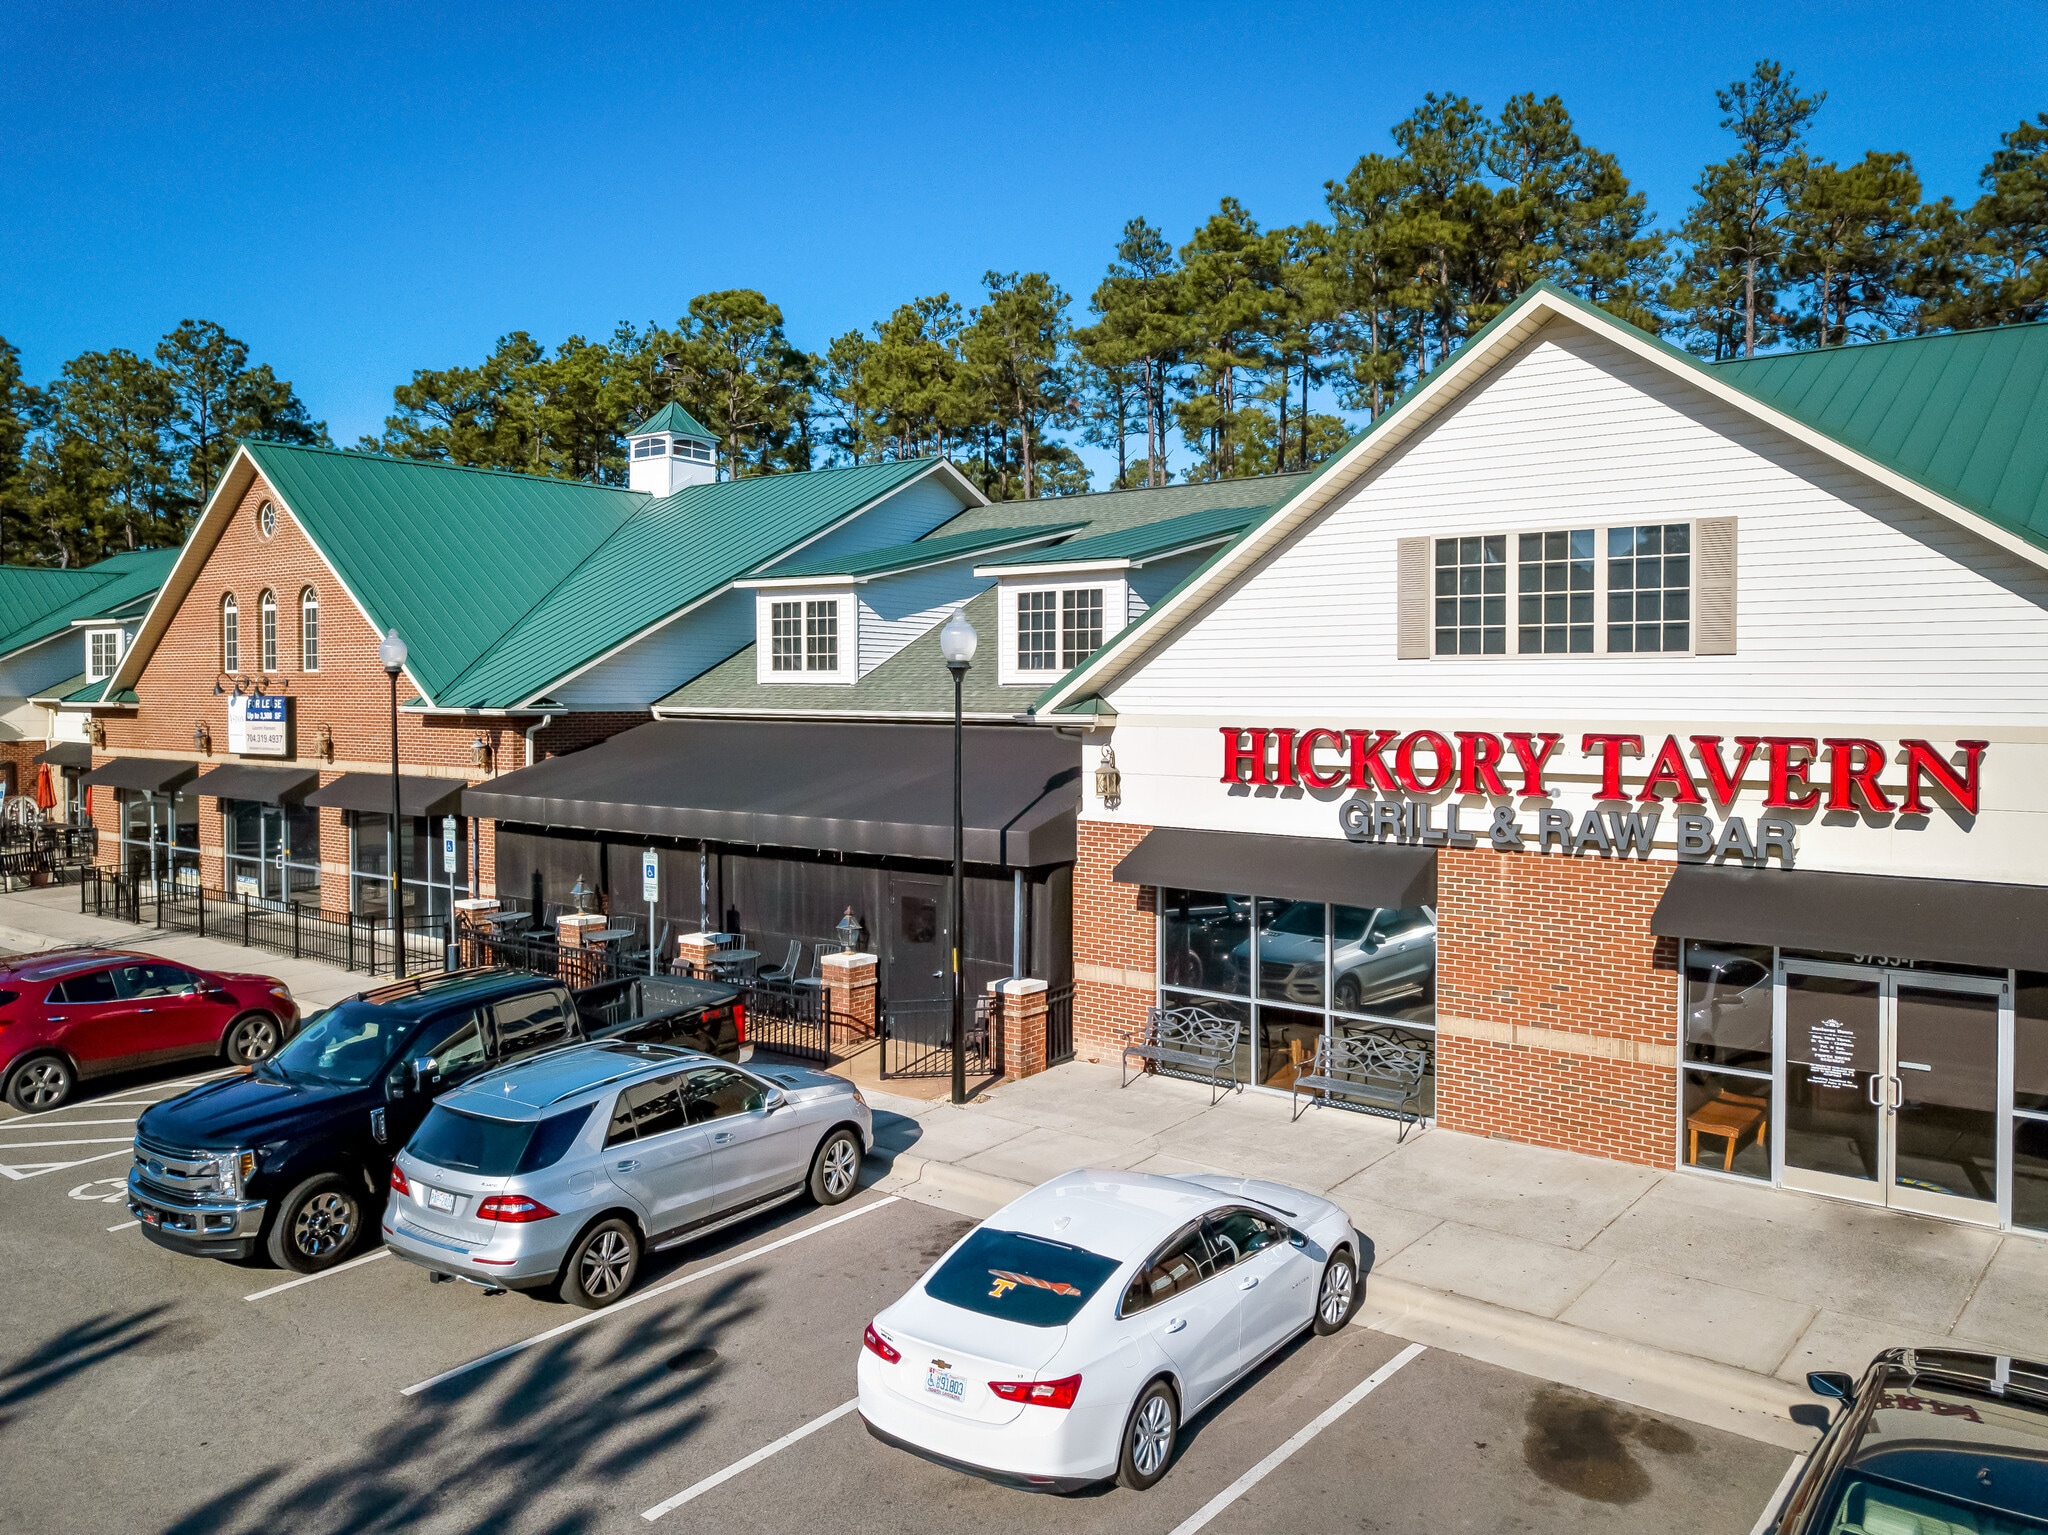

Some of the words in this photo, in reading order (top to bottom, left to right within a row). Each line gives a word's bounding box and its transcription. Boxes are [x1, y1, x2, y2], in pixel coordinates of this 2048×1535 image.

[248, 699, 260, 709] FOR
[261, 699, 282, 709] LEASE
[246, 733, 283, 743] 704.319.4937
[1219, 727, 1563, 798] HICKORY
[1582, 733, 1990, 816] TAVERN
[1338, 798, 1476, 841] GRILL
[1488, 805, 1523, 844] &
[1538, 808, 1659, 852] RAW
[1677, 813, 1797, 861] BAR
[988, 1278, 1017, 1298] T
